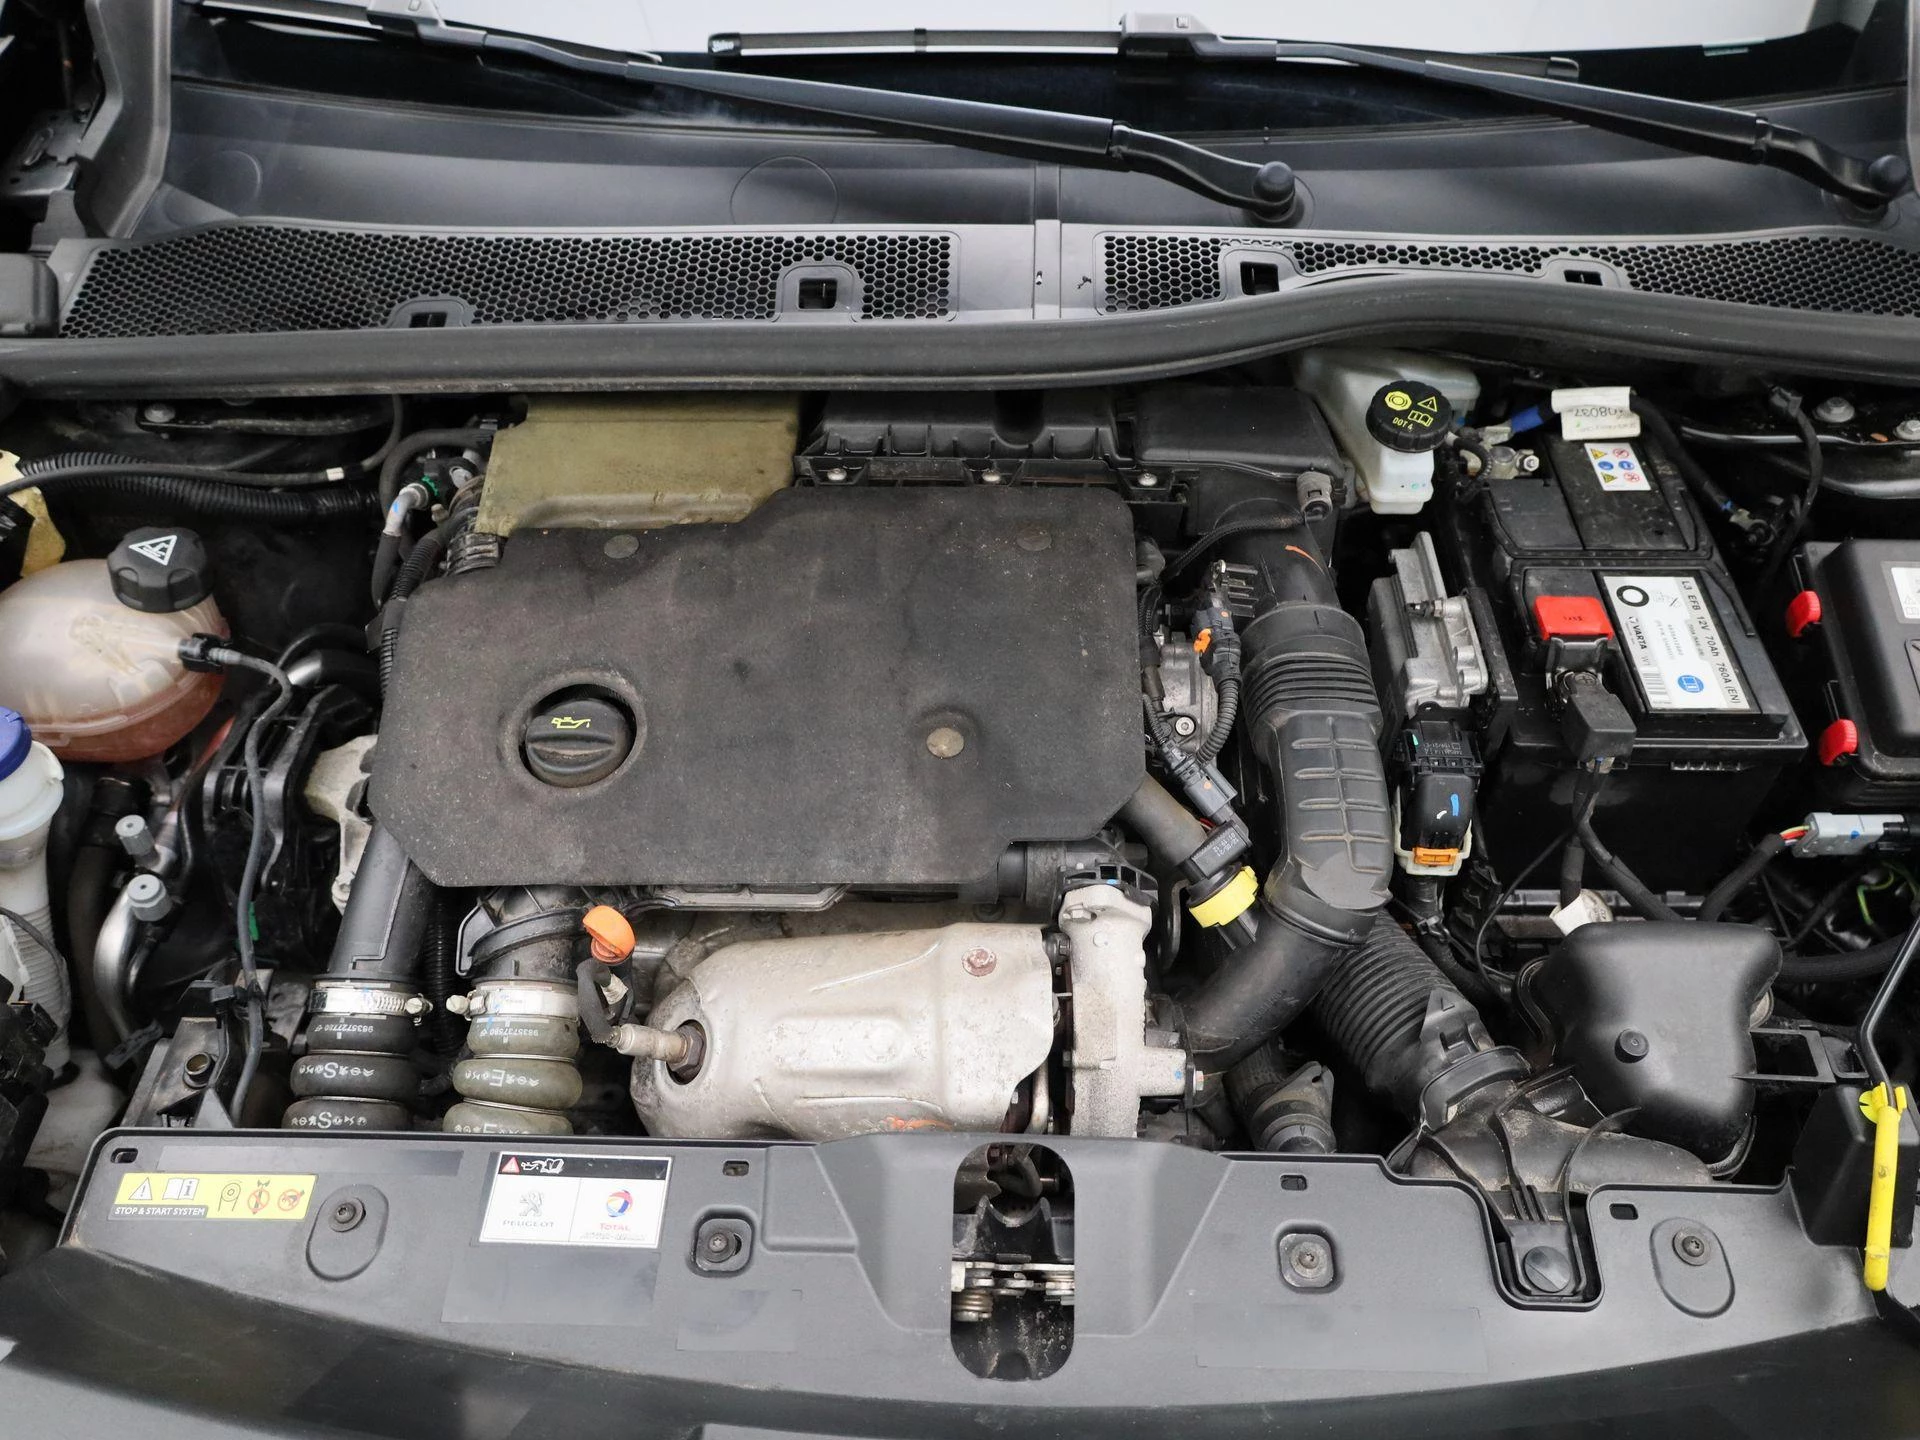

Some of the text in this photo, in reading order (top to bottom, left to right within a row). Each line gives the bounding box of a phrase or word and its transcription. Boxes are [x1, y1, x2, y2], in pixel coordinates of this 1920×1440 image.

[1633, 625, 1648, 650] VARTA
[1688, 595, 1701, 610] EFB
[1697, 616, 1711, 631] 12V
[1704, 635, 1720, 657] 70Ah
[1716, 662, 1732, 683] 760A
[1724, 686, 1742, 704] (EN)
[114, 1206, 205, 1216] STOP & START SYSTEM
[502, 1219, 554, 1228] PEUGEOT
[600, 1223, 631, 1232] TOTAL
